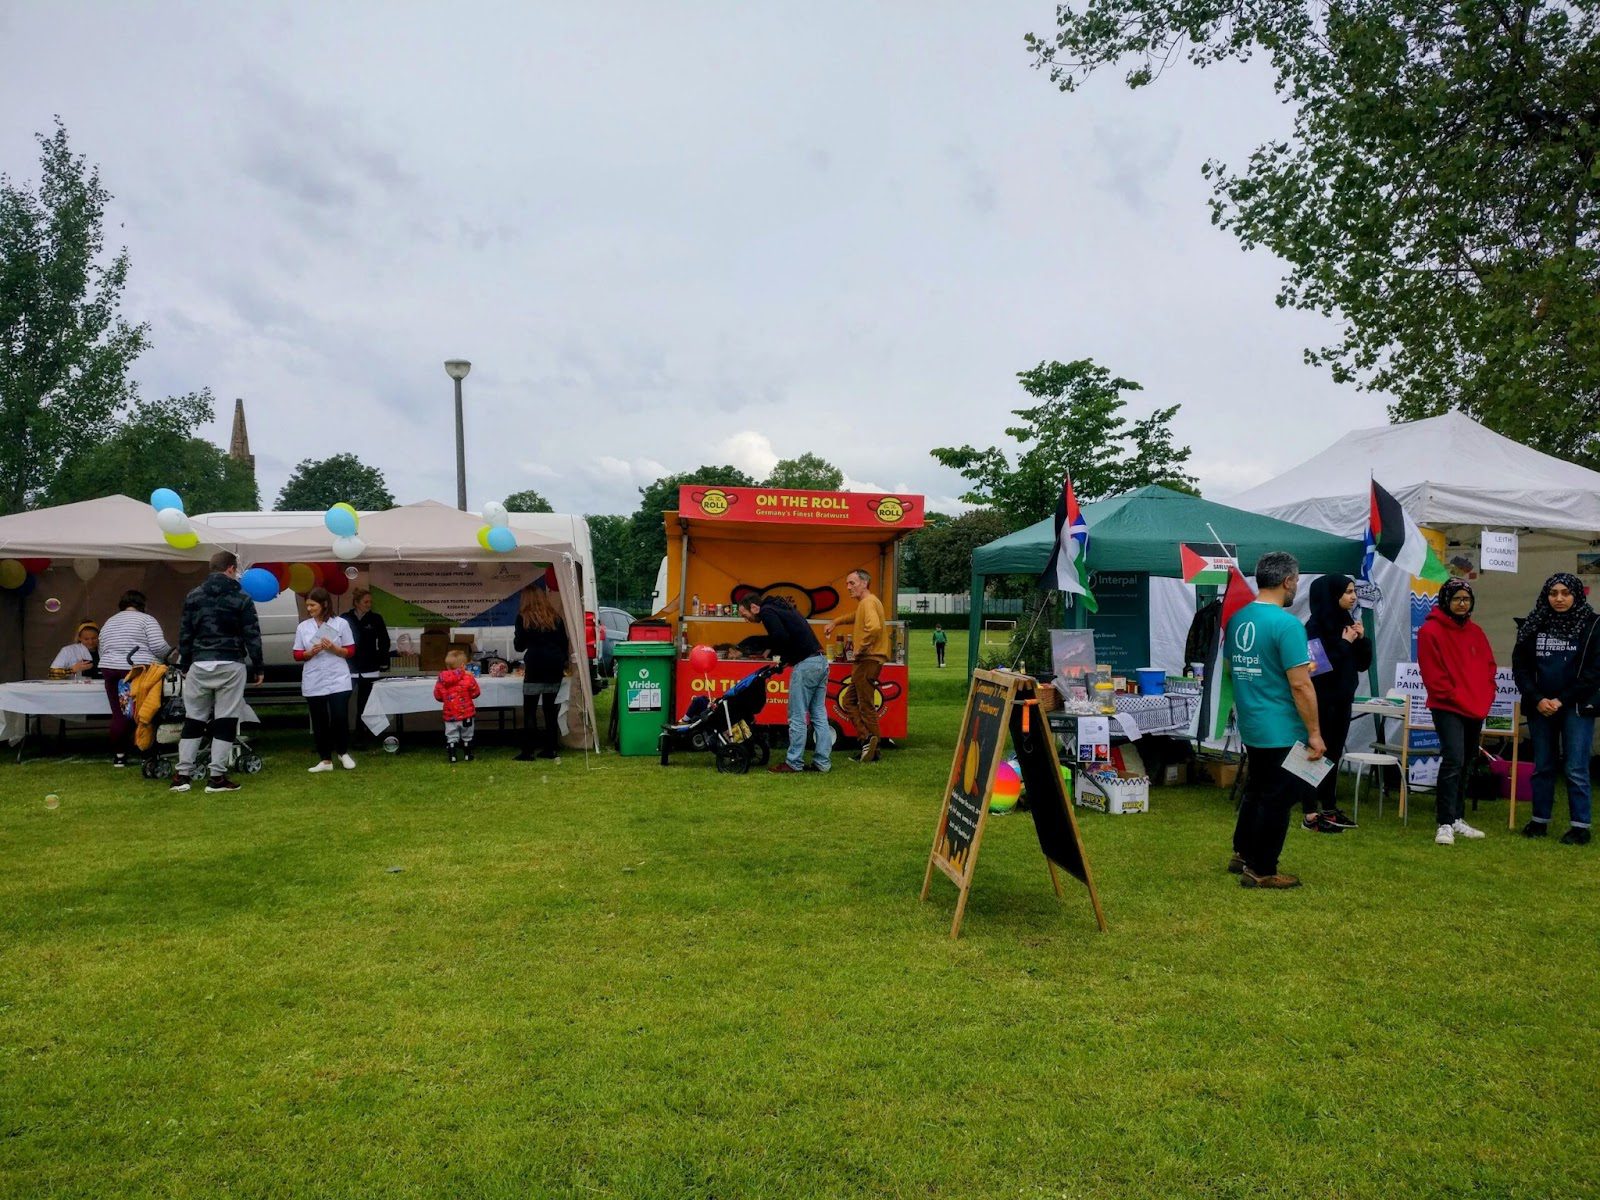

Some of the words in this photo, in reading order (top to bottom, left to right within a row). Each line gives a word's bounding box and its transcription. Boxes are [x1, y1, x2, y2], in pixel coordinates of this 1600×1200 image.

[703, 501, 725, 509] ROLL
[755, 494, 777, 506] ON
[780, 495, 808, 508] THE
[811, 497, 849, 510] ROLL
[755, 508, 791, 517] Germany's
[793, 510, 814, 518] Finest
[815, 511, 849, 519] Bratwurst
[1098, 574, 1138, 587] Interpal
[1406, 668, 1422, 677] FA
[627, 680, 660, 689] Viridor
[691, 678, 716, 692] ON
[766, 680, 789, 693] OL
[1396, 681, 1424, 690] PAINT
